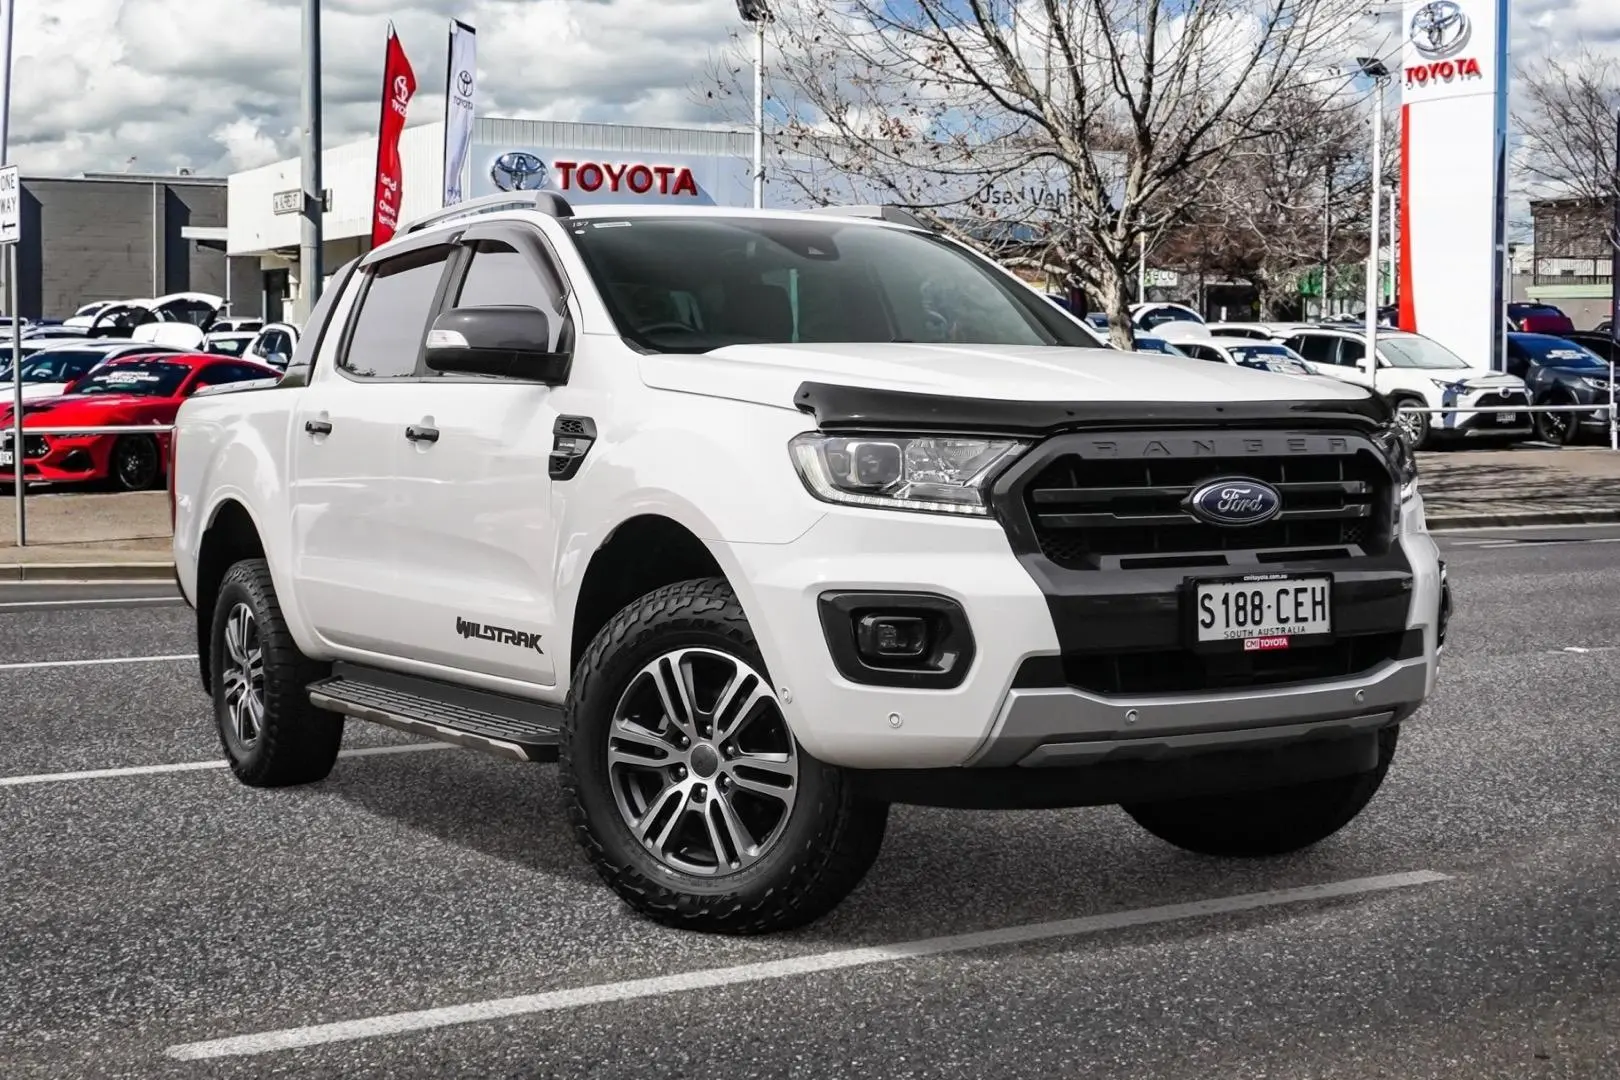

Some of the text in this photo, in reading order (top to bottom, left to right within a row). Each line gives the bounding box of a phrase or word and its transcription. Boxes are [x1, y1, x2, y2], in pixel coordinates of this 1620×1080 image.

[1404, 57, 1481, 84] TOYOTA
[1, 173, 16, 191] ONE
[554, 161, 698, 196] TOYOTA
[978, 184, 1025, 204] Used
[0, 196, 17, 213] WAY
[1091, 437, 1348, 457] RANGER
[1216, 487, 1263, 513] Ford
[455, 616, 545, 655] WILDTRAK
[1223, 625, 1306, 639] SOUTH AUSTRALIA
[1260, 637, 1288, 648] TOYOTA
